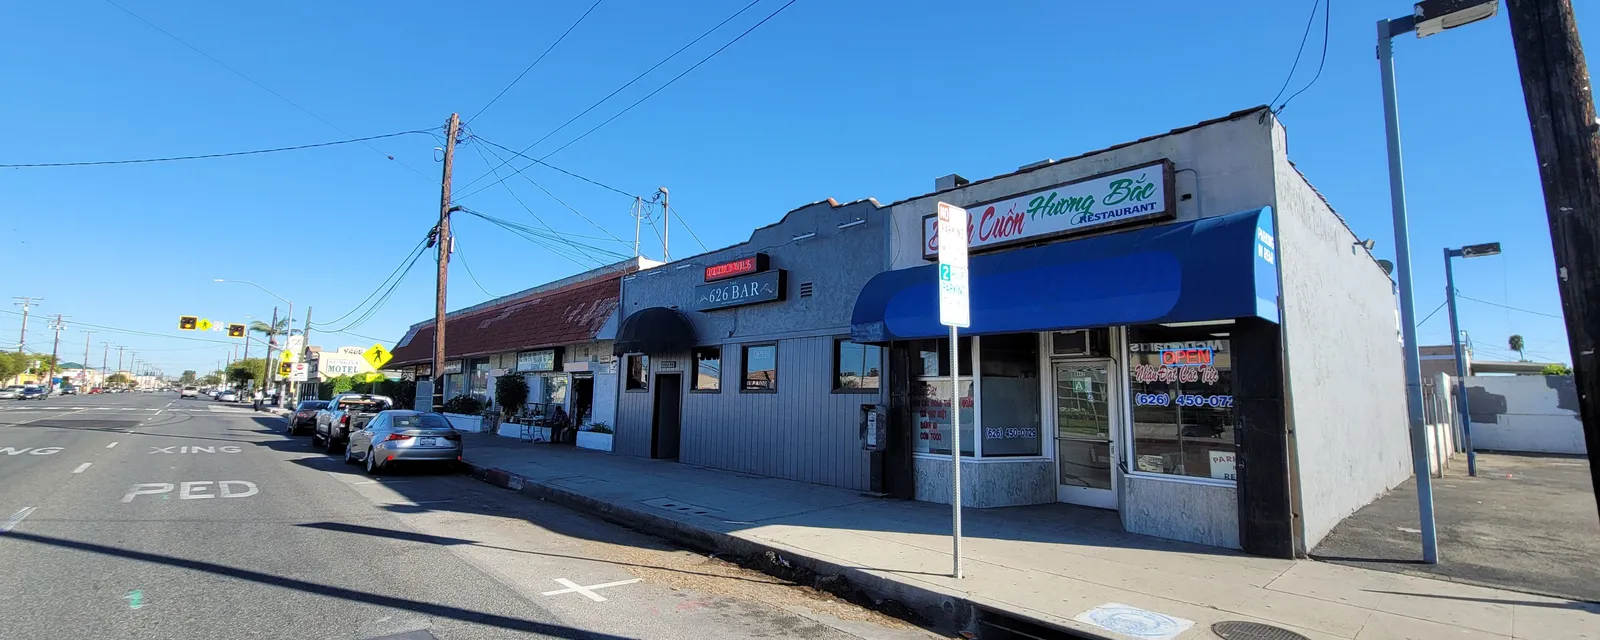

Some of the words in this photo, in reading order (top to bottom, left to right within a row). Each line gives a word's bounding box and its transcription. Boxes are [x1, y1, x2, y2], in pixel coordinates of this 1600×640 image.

[1102, 172, 1157, 206] Bắc
[940, 204, 949, 220] NO
[1079, 201, 1157, 224] RESTAURANT
[979, 203, 1027, 242] Cuốn
[1257, 226, 1275, 250] PARKING
[942, 264, 950, 280] 2
[709, 286, 729, 303] 626
[731, 281, 760, 300] BAR
[1162, 349, 1211, 365] OPEN
[327, 365, 359, 373] MOTEL
[1135, 392, 1170, 407] (626)
[985, 426, 1003, 440] (626)
[1004, 427, 1037, 439] 450-0729
[148, 445, 243, 454] XING
[120, 480, 259, 503] PED
